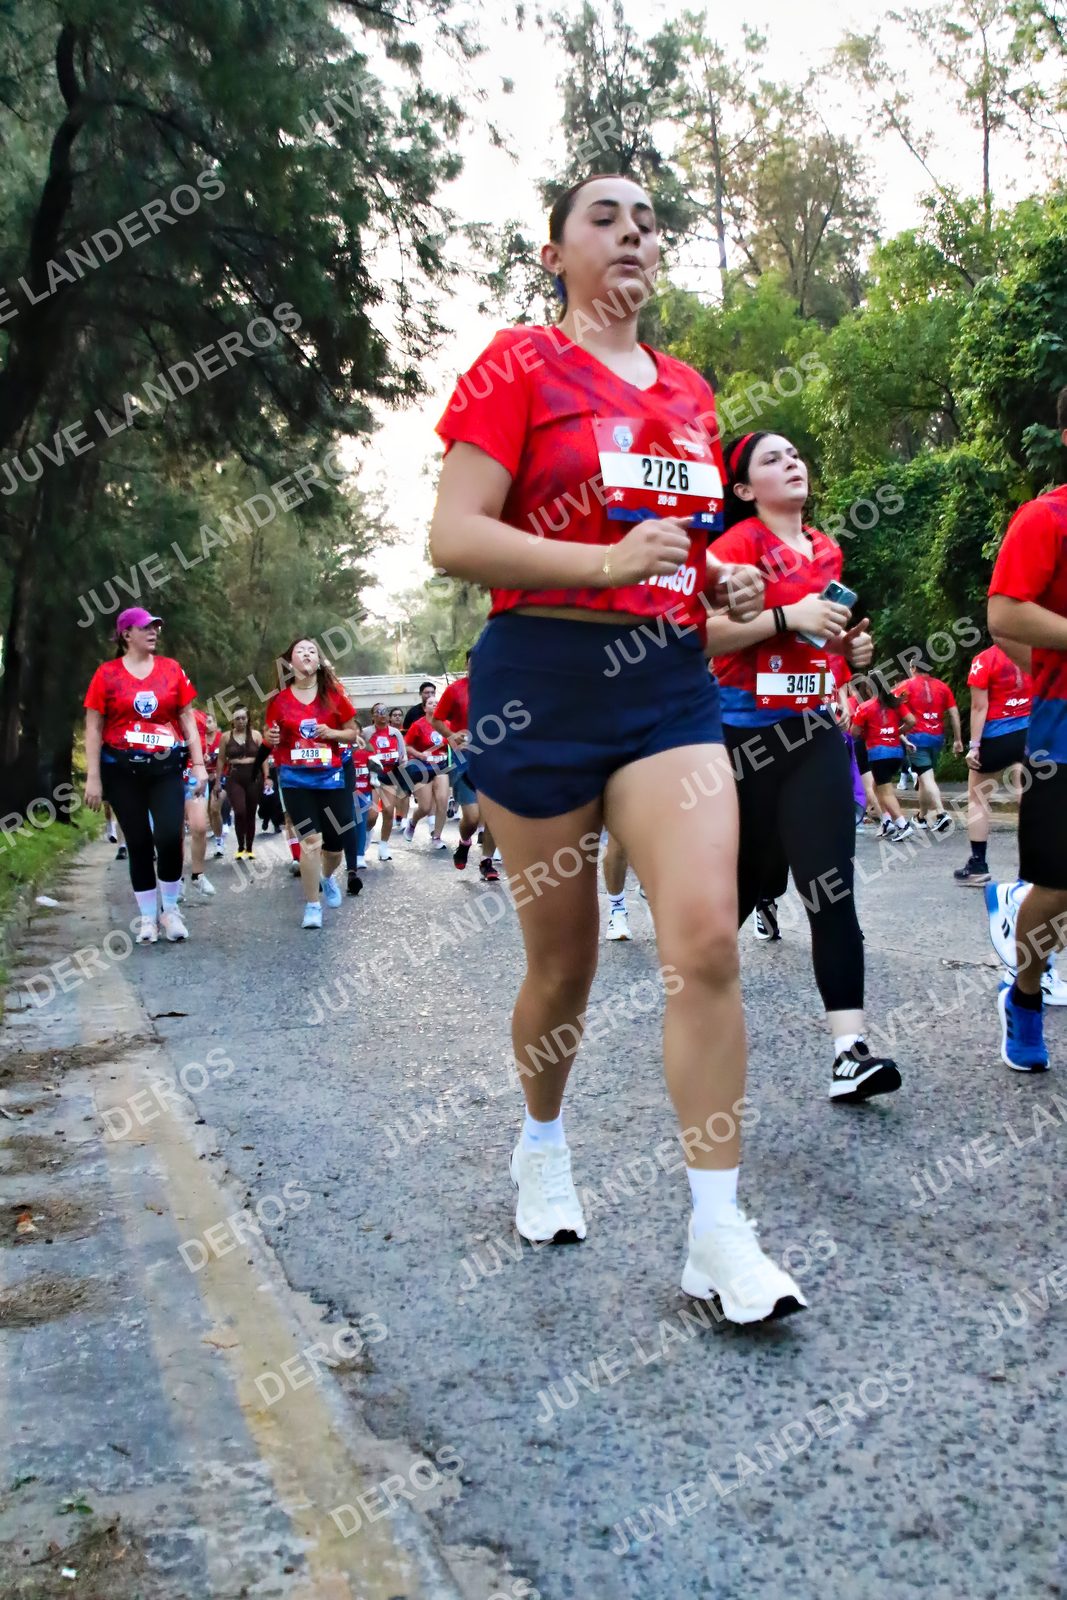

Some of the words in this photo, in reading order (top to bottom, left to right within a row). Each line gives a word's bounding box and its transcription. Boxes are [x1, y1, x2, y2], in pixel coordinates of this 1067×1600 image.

[642, 458, 688, 491] 2726
[786, 675, 816, 694] 3415
[142, 734, 160, 745] 1437
[301, 749, 320, 758] 2438
